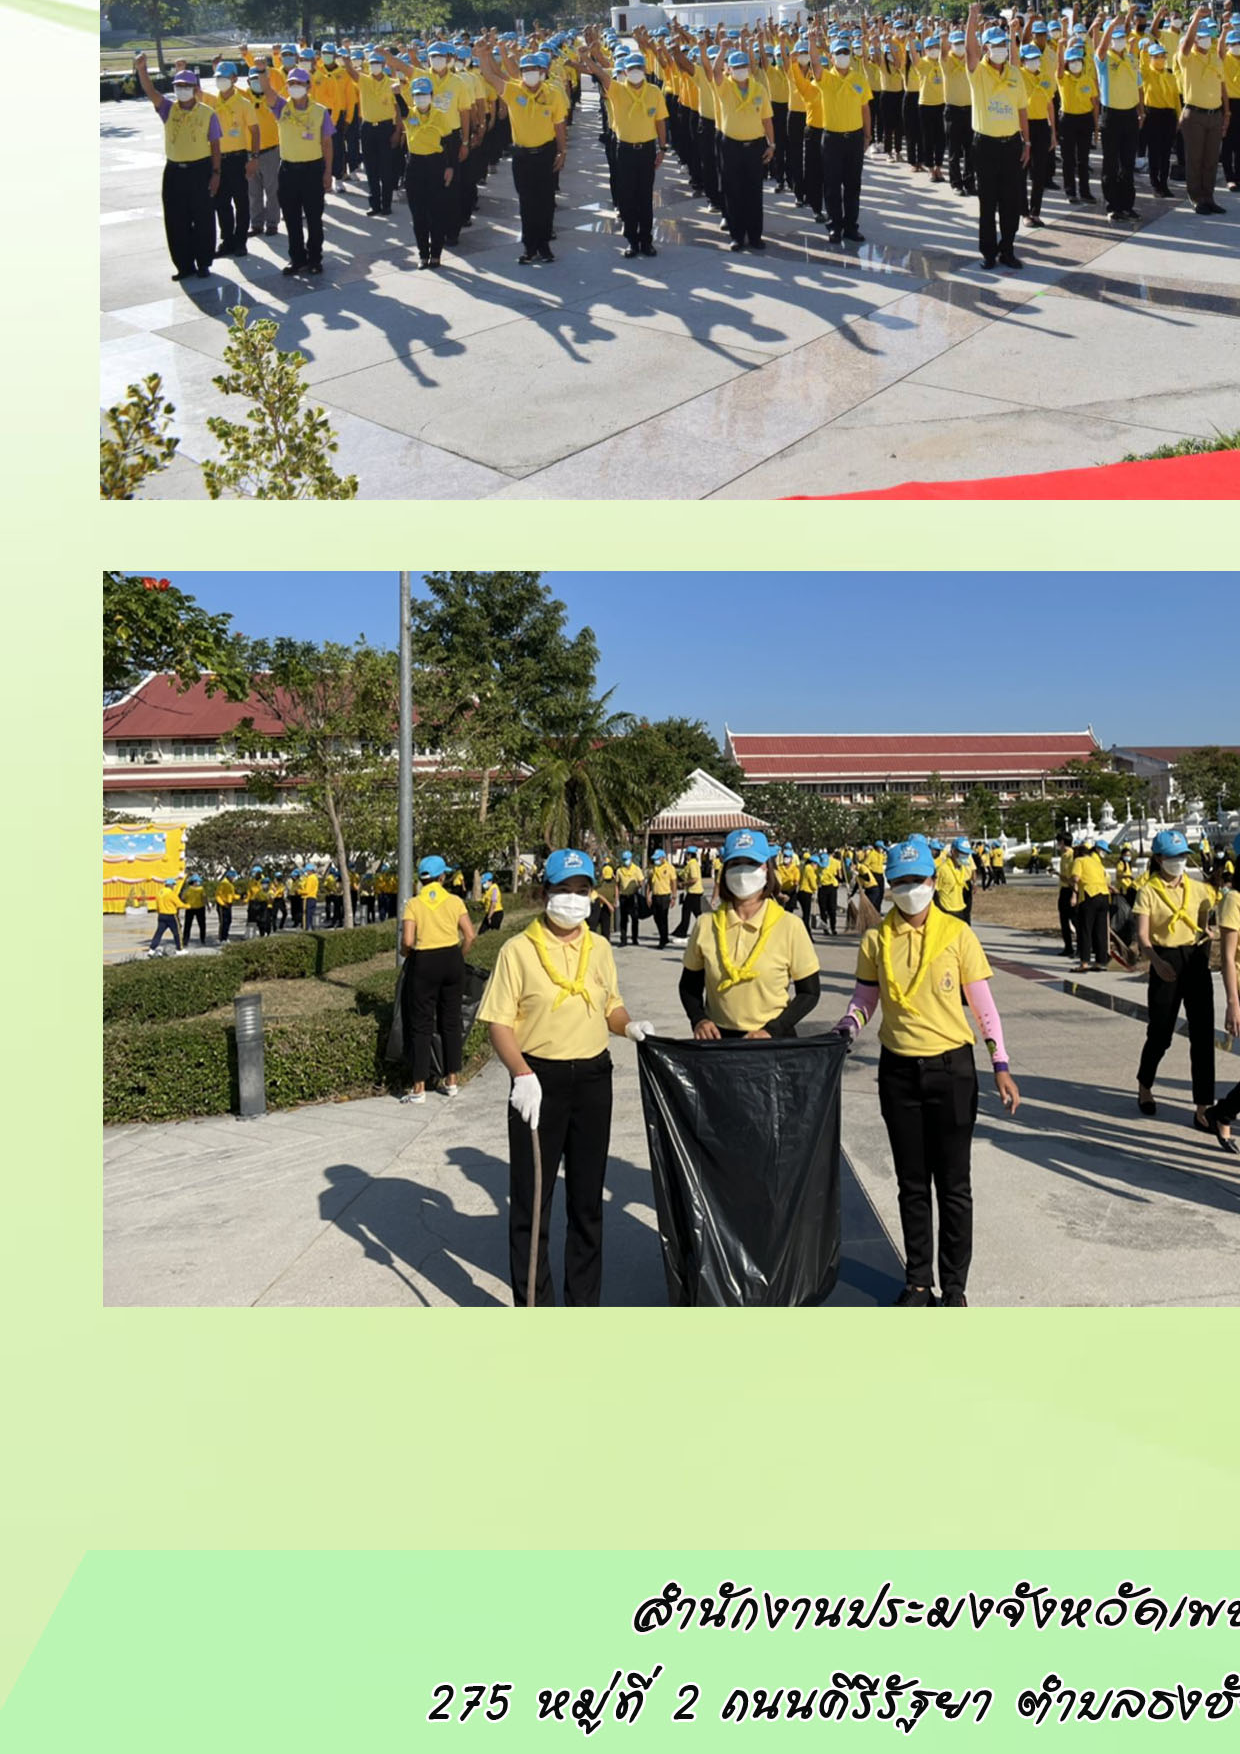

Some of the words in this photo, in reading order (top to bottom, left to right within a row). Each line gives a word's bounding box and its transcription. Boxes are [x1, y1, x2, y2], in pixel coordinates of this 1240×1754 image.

[428, 1683, 512, 1722] 275
[538, 1665, 663, 1734] หมู่ที่
[673, 1683, 699, 1722] 2
